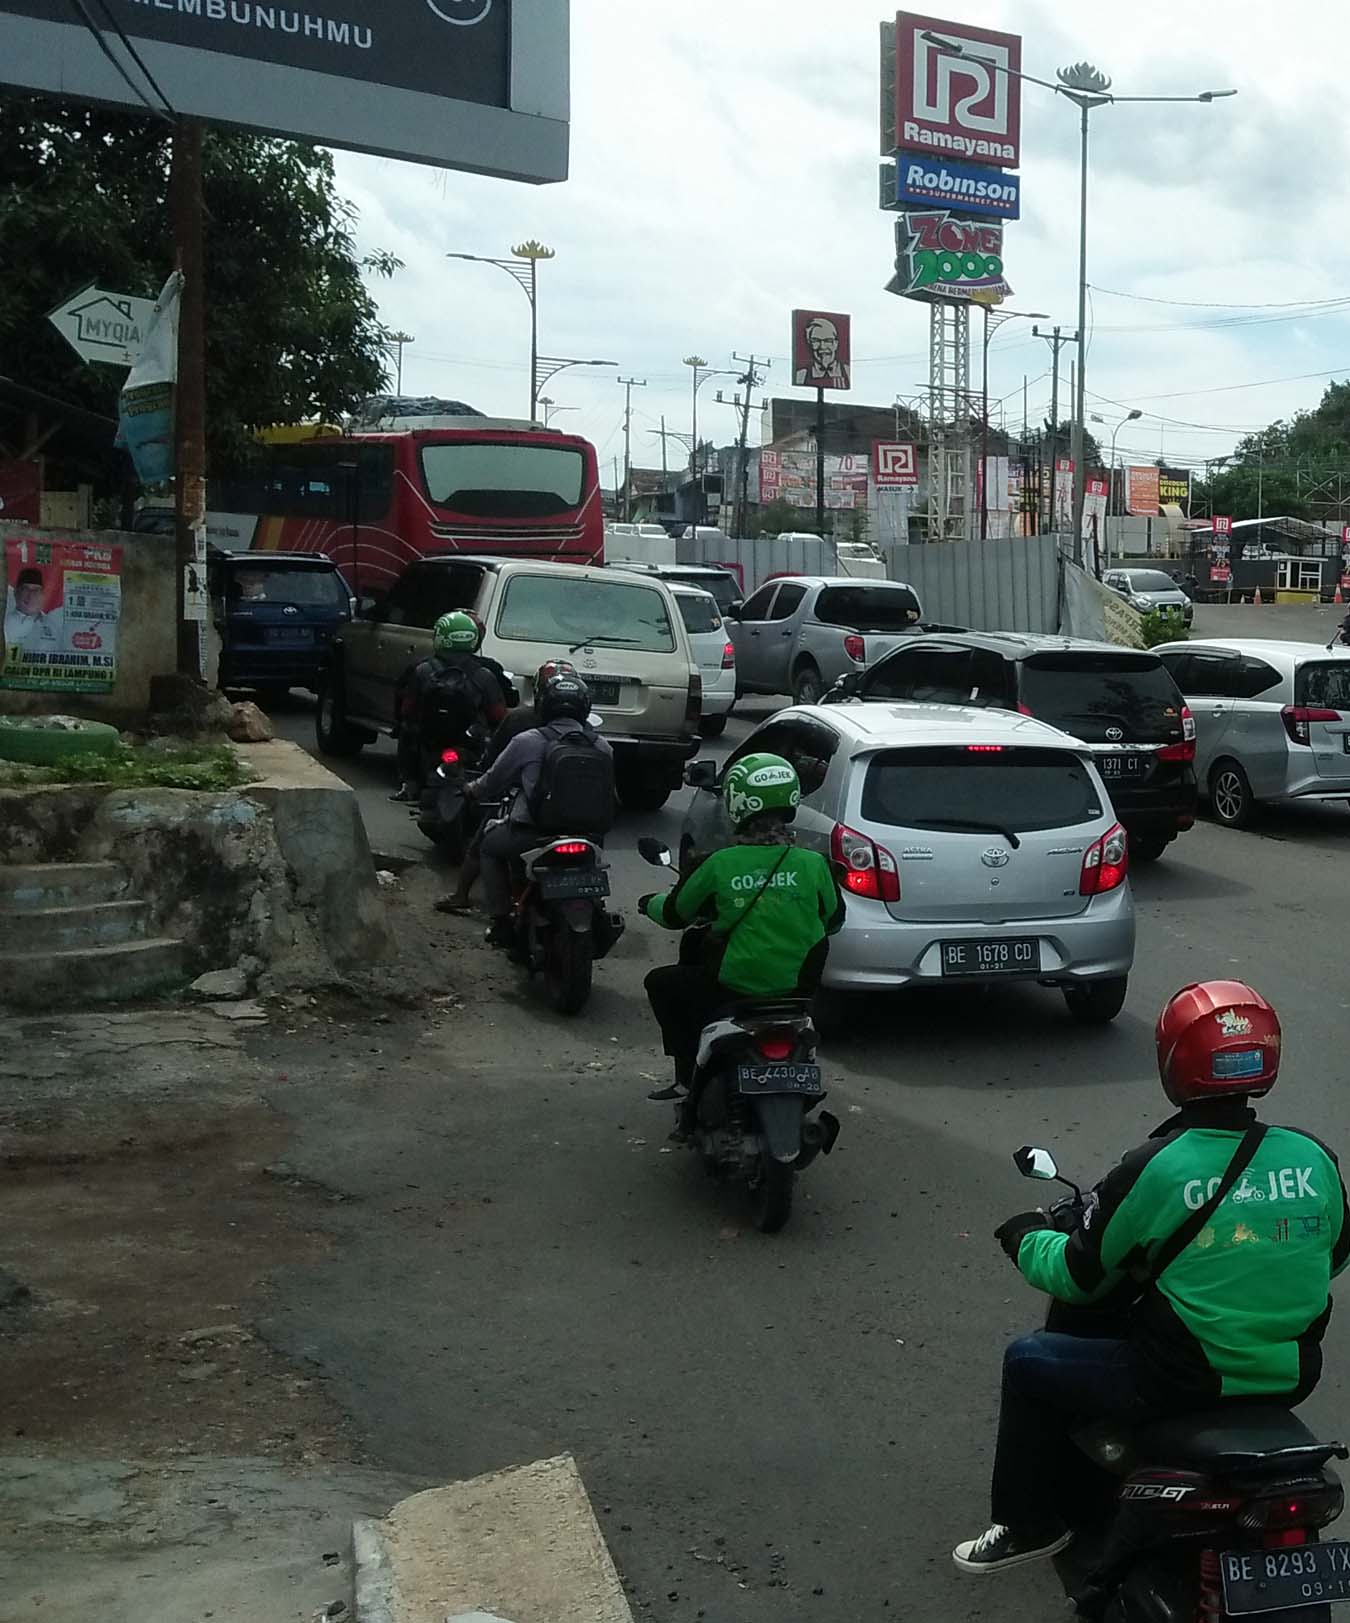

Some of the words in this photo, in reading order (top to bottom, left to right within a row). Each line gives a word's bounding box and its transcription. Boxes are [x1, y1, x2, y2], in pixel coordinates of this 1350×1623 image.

[133, 0, 373, 49] MBUNUHMU
[903, 121, 1016, 160] Ramayana
[906, 165, 1017, 201] Robinson
[929, 190, 991, 205] SUPERMARKET
[909, 216, 1002, 257] ZONE
[910, 249, 1004, 288] 2000
[86, 317, 143, 345] MYQIA
[1160, 486, 1188, 497] KING
[1103, 758, 1121, 769] 1371
[1127, 758, 1138, 770] CT
[754, 773, 768, 783] GO
[776, 770, 792, 780] JEK
[731, 873, 754, 890] GO
[769, 871, 799, 887] JEK
[948, 946, 966, 964] BE
[976, 944, 1008, 962] 1678
[1014, 943, 1032, 961] CD
[742, 1067, 757, 1079] BE
[765, 1066, 796, 1078] 4430
[1183, 1176, 1220, 1210] GO
[1268, 1166, 1319, 1201] JEK
[1159, 1487, 1197, 1502] GT
[1229, 1556, 1254, 1582] BE
[1265, 1551, 1317, 1578] 8293
